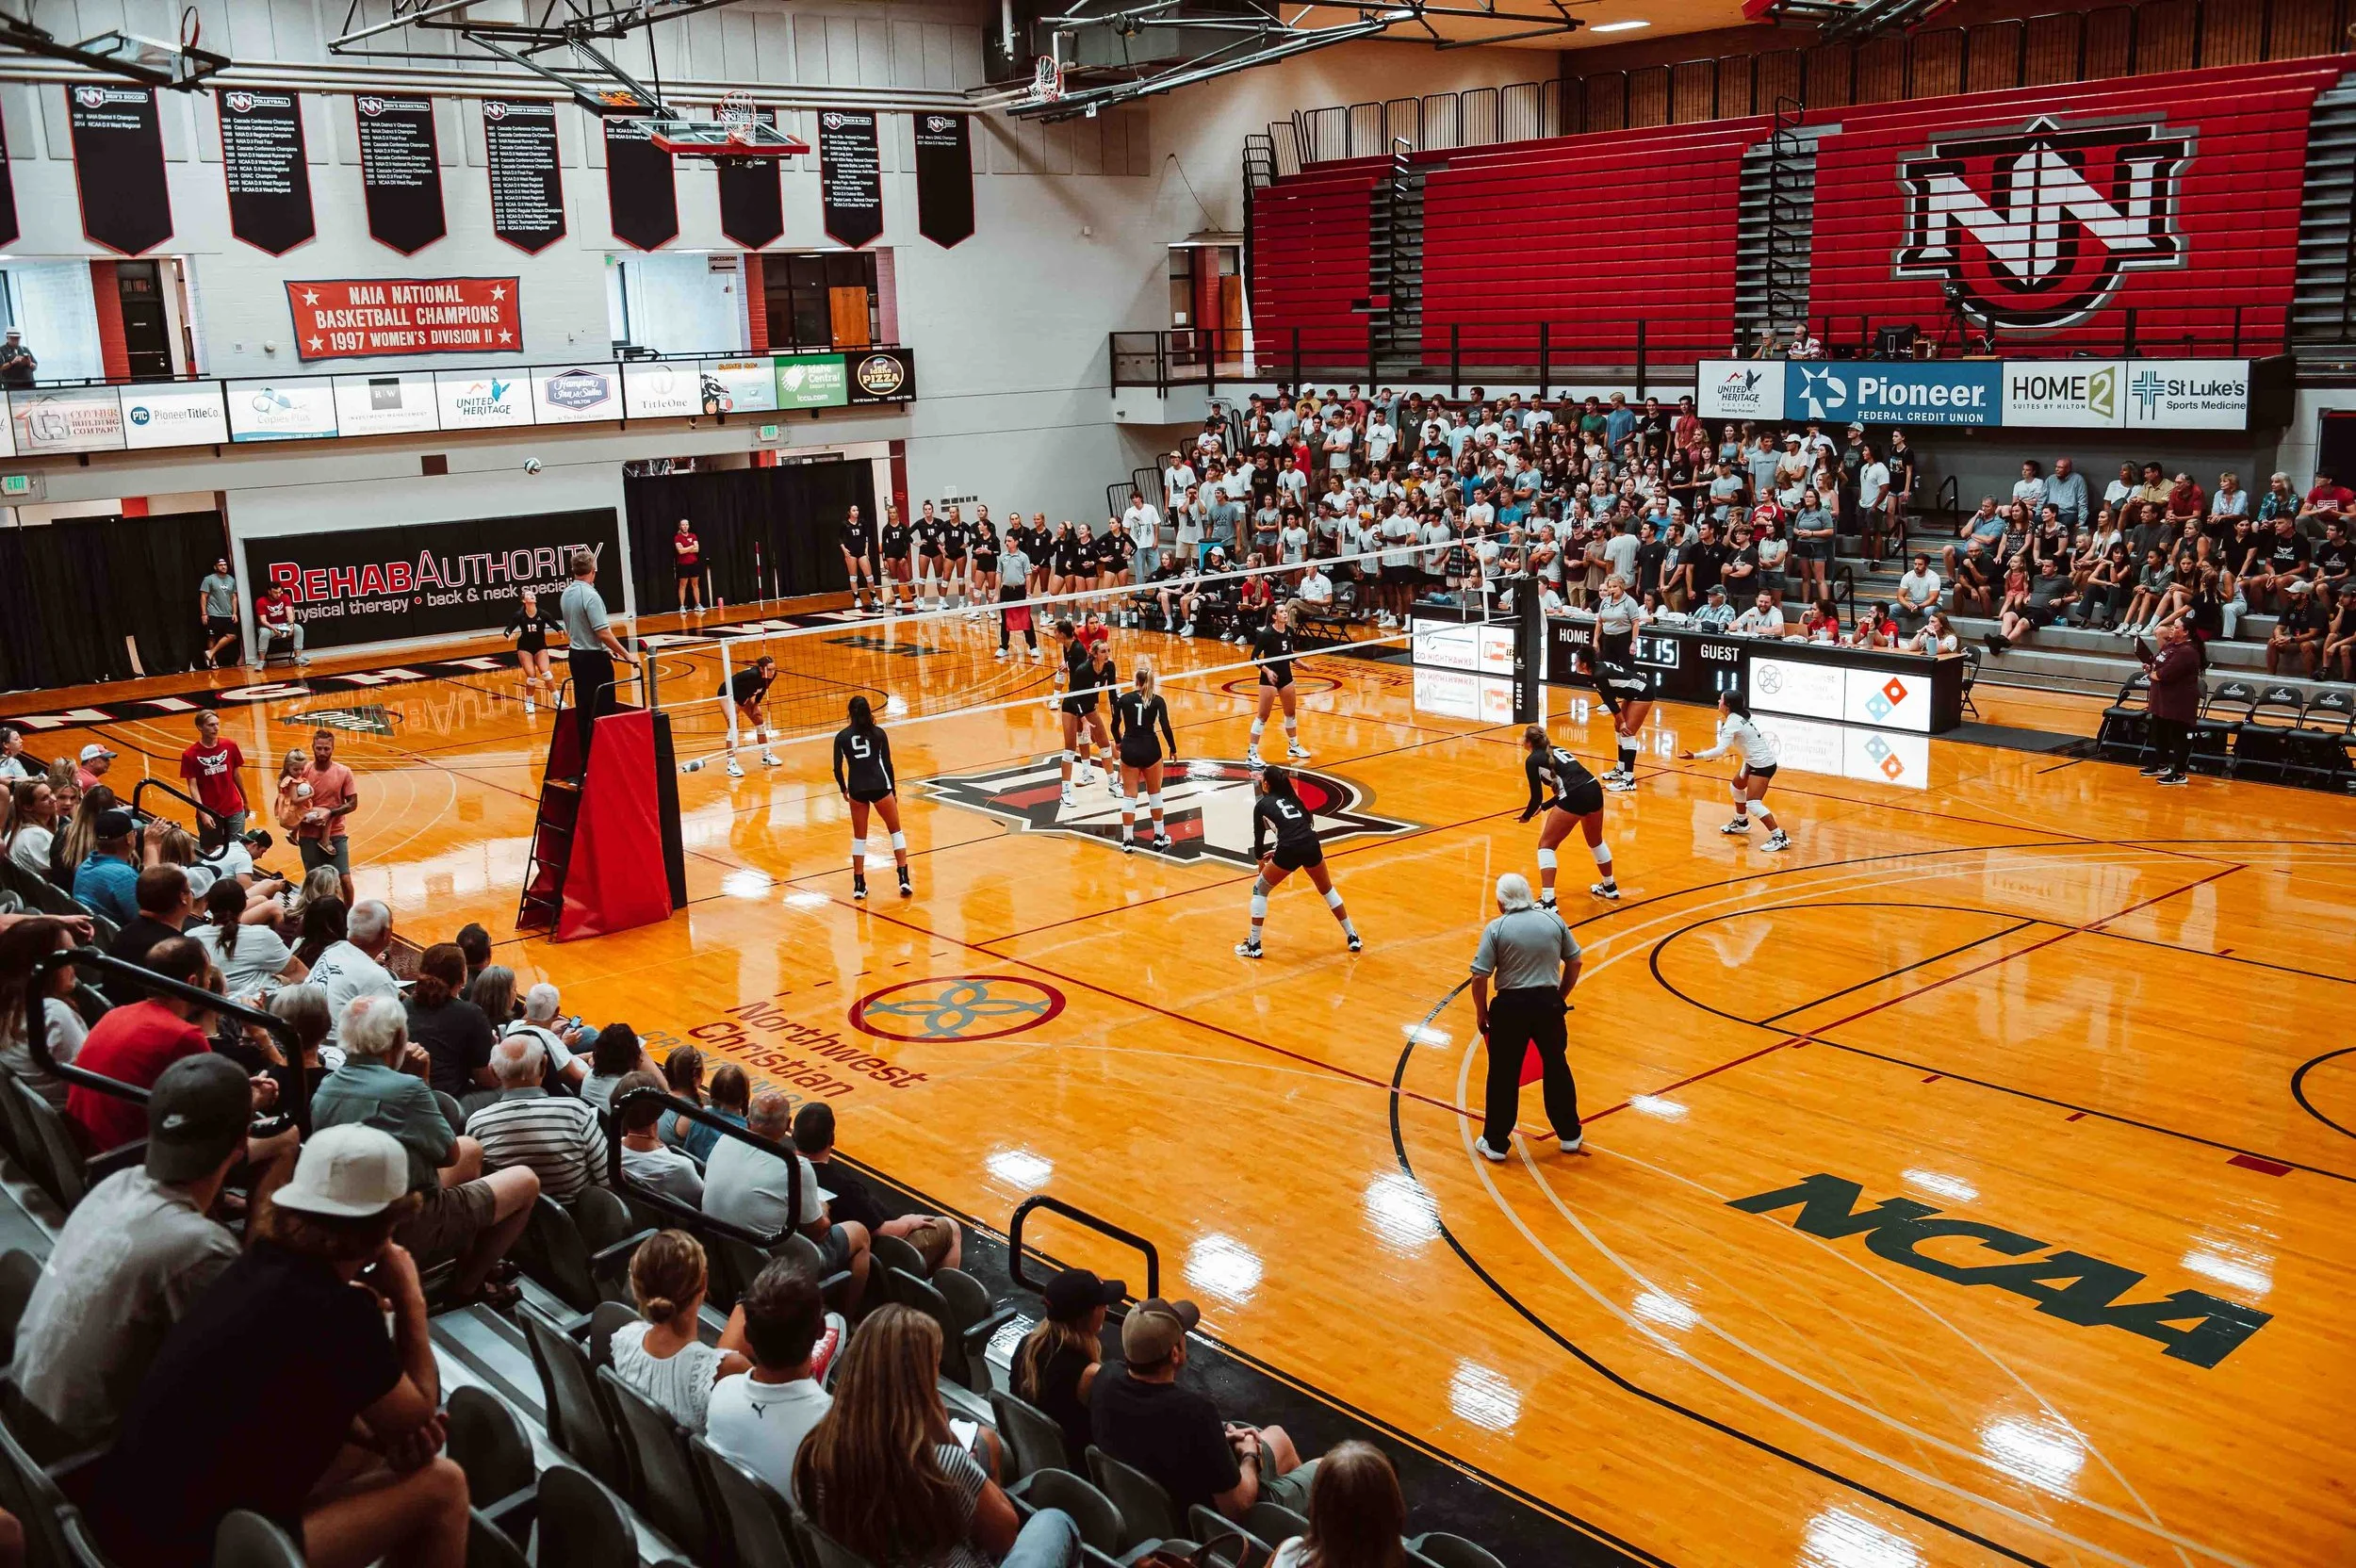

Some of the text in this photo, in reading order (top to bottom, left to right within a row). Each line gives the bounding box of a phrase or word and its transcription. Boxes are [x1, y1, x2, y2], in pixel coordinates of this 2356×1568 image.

[349, 285, 464, 305] NAIA NATIONAL
[315, 305, 499, 329] BASKETBALL CHAMPIONS
[330, 329, 493, 351] 1997 WOMEN'S DIVISION II
[808, 364, 829, 374] Idaho
[553, 378, 598, 390] Hampton
[809, 372, 841, 384] Central
[862, 372, 900, 384] PIZZA
[1717, 384, 1747, 394] UNITED
[1857, 377, 1985, 407] Pioneer
[2013, 376, 2086, 400] HOME
[2167, 379, 2245, 397] St Luke's
[456, 397, 495, 409] UNITED
[641, 399, 688, 409] TitleOne
[1722, 393, 1760, 403] HERITAGE
[463, 404, 511, 416] HERITAGE
[2166, 400, 2247, 411] Sports Medicine
[133, 411, 148, 421] PTC
[1857, 411, 1984, 423] FEDERAL CREDIT UNION
[73, 426, 120, 435] COMPANY
[293, 577, 573, 623] hysical therapy back & neck speciali
[528, 624, 537, 632] 12
[1282, 640, 1287, 651] 5
[1560, 628, 1740, 662] HOME GUEST
[1415, 651, 1426, 660] GO
[1134, 703, 1143, 727] 1
[724, 1000, 928, 1090] Northwest
[687, 1021, 855, 1099] Christian
[1724, 1172, 2275, 1370] NCAA
